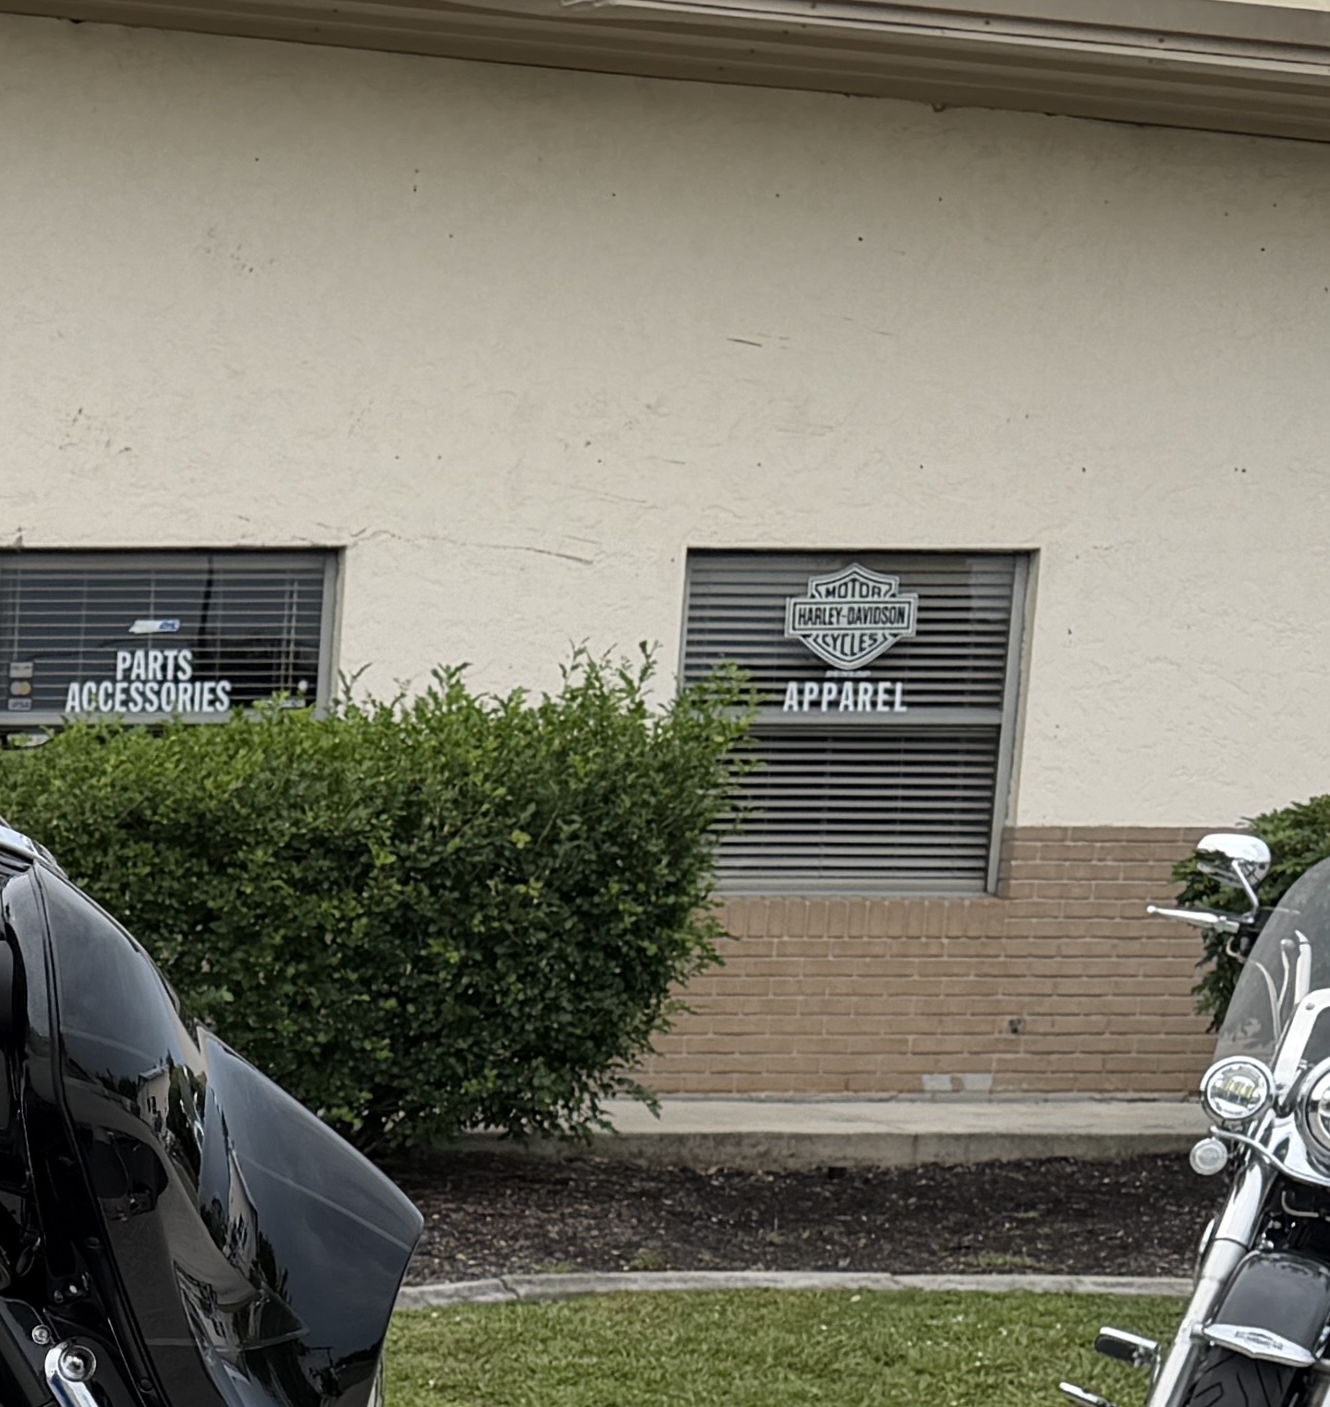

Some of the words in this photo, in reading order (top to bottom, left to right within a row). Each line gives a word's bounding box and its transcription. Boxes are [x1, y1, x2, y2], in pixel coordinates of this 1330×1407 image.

[825, 578, 882, 598] MOTOR
[798, 606, 905, 626] HARLEY-DAVIDSON
[822, 633, 878, 656] CYCLES
[116, 649, 193, 681] PARTS
[64, 680, 232, 713] ACCESSORIES
[783, 681, 908, 713] APPAREL
